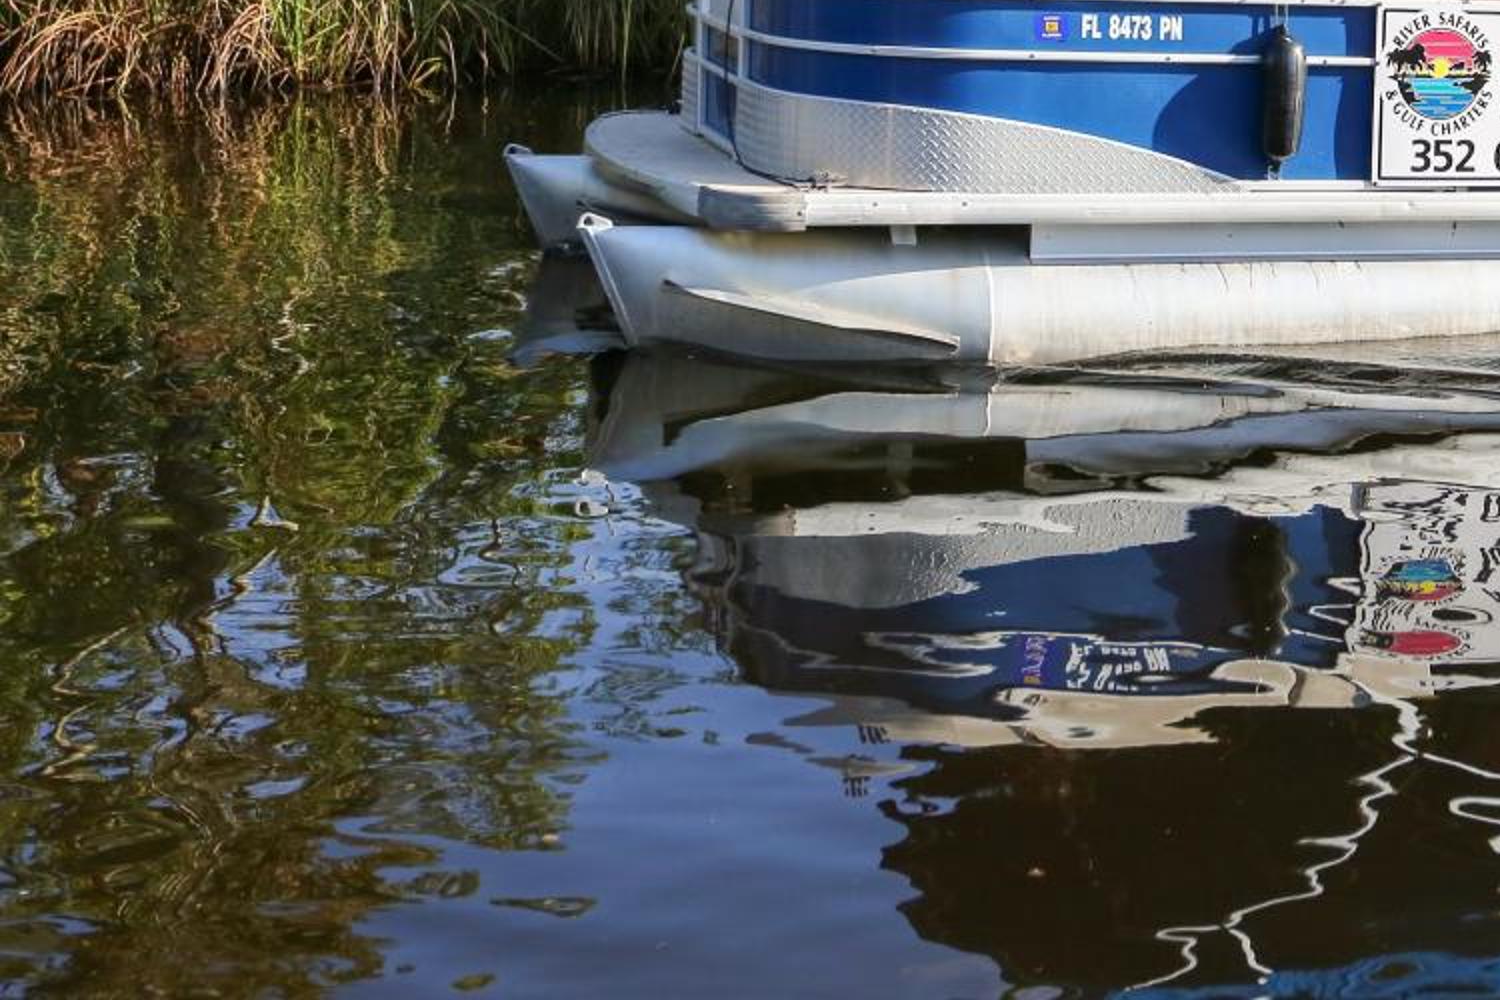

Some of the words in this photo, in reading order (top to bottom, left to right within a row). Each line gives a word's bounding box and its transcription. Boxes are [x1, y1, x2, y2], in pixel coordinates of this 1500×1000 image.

[1080, 13, 1102, 39] FL
[1109, 14, 1152, 41] 8473
[1159, 15, 1183, 41] PN
[1393, 15, 1431, 48] RIVER
[1439, 11, 1489, 49] SAFARIS
[1393, 102, 1425, 131] GULF
[1431, 90, 1493, 137] CHARTERS
[1410, 139, 1475, 173] 352
